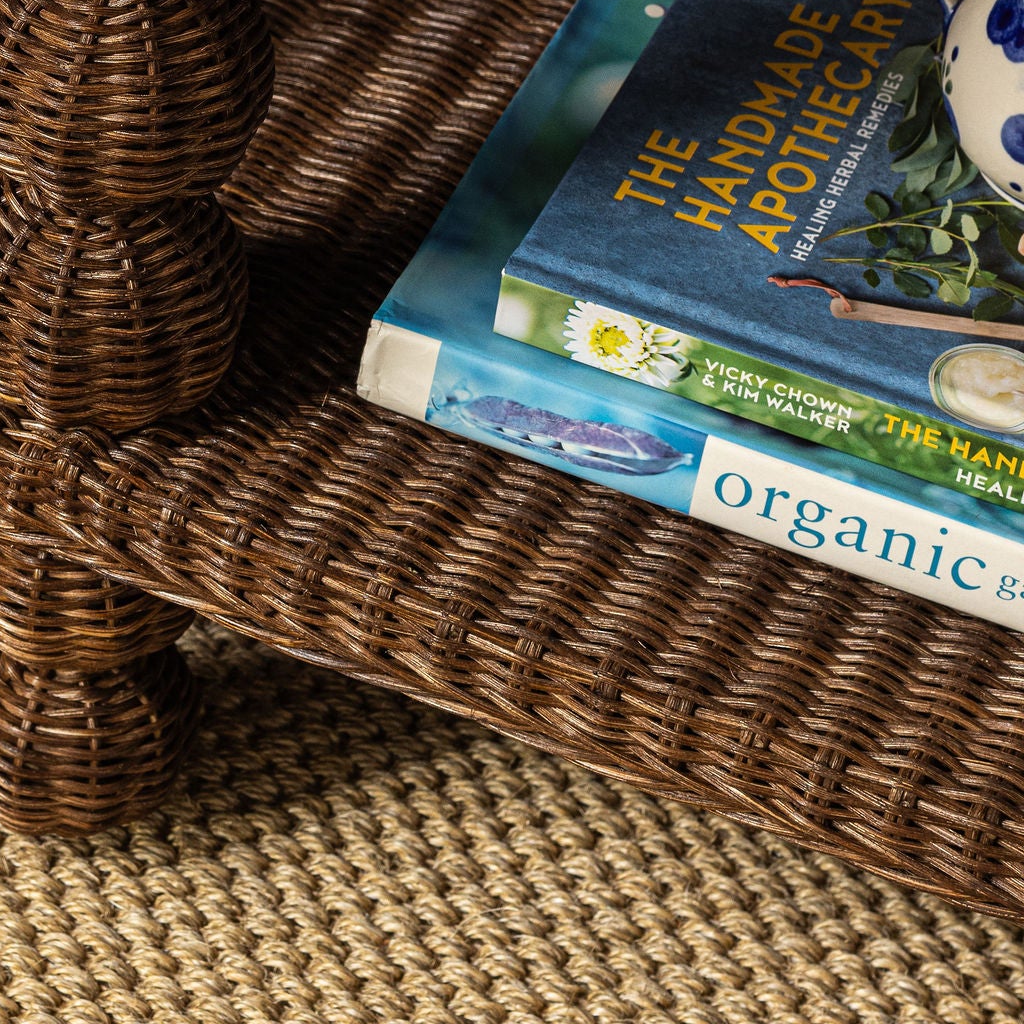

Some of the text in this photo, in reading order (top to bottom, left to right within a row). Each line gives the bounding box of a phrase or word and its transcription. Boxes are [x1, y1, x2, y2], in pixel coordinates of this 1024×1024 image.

[674, 3, 841, 232] HANDMADE
[614, 129, 700, 207] THE
[789, 71, 904, 262] HEALING HERBAL REMEDIES
[701, 373, 851, 434] & KIM WALKER
[704, 358, 853, 419] VICKY CHOWN
[884, 413, 1024, 479] THE HAN
[714, 472, 1024, 601] organic g
